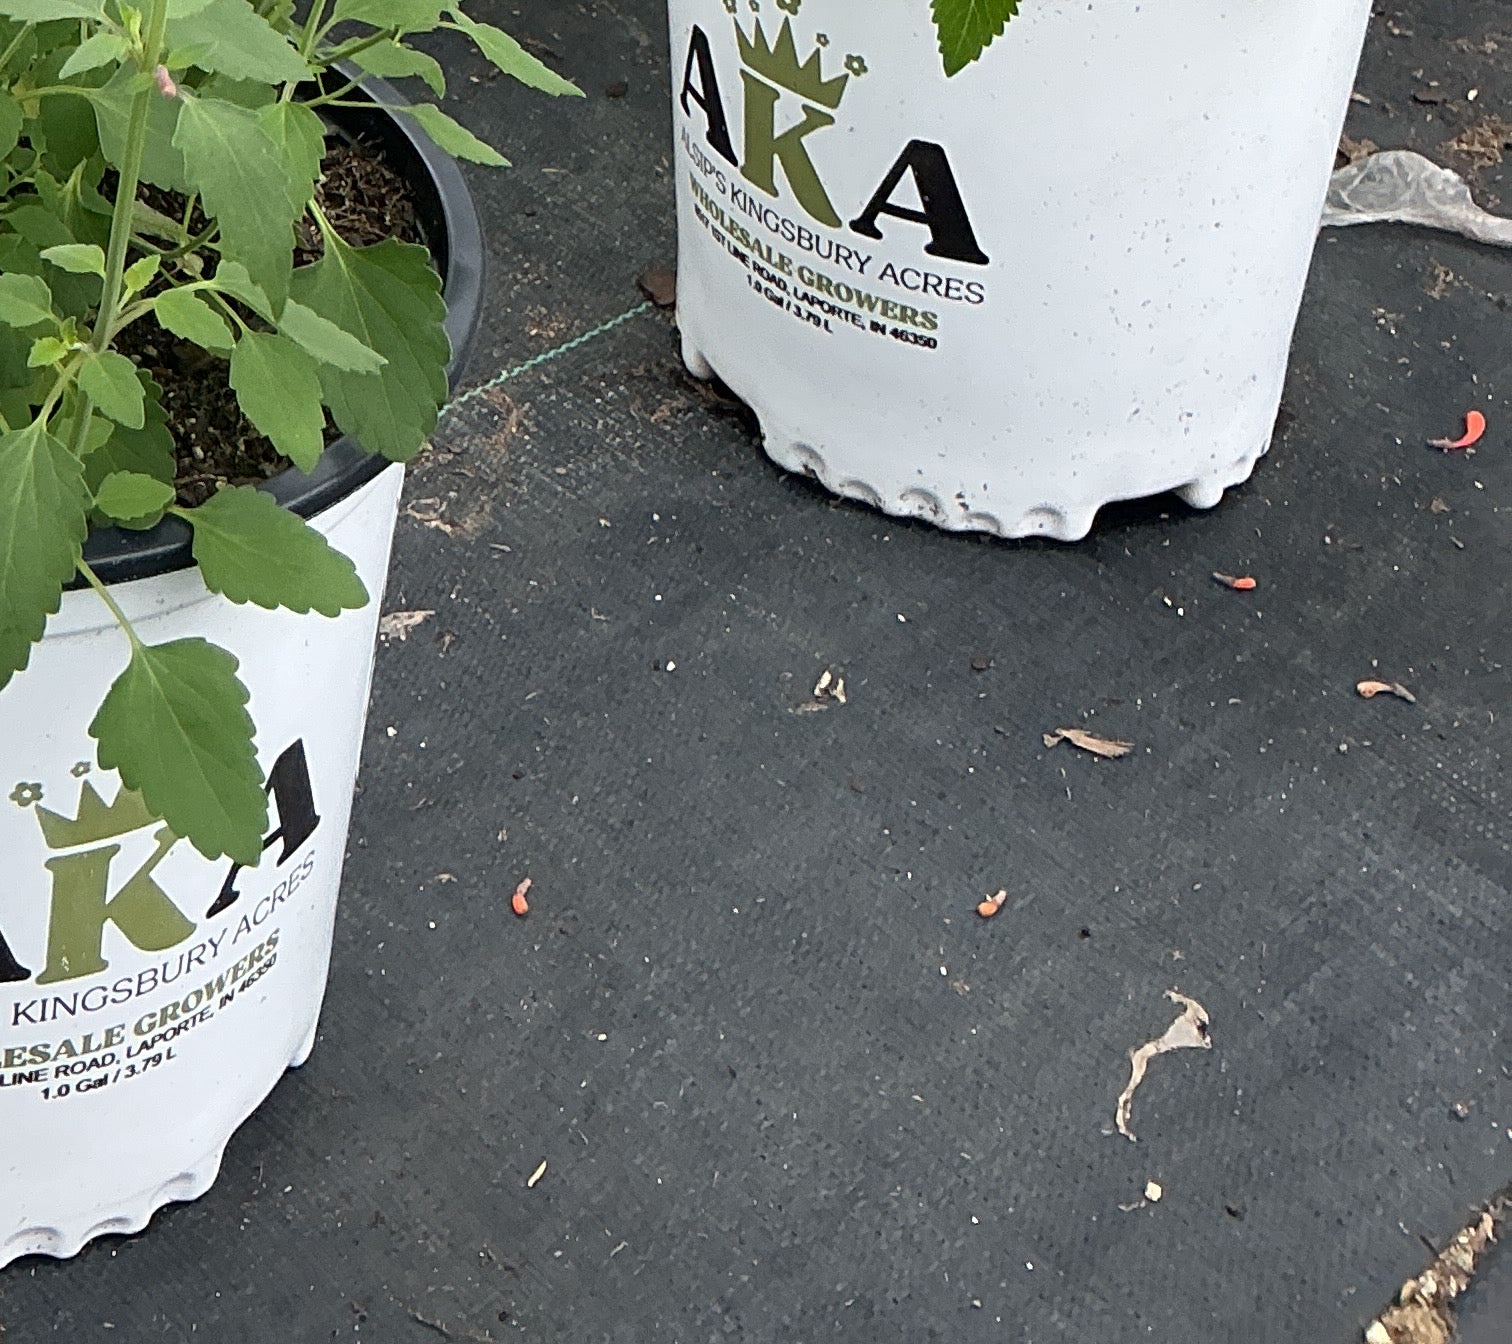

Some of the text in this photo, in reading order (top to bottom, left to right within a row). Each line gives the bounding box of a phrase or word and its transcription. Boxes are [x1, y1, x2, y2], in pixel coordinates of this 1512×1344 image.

[680, 23, 990, 266] AKA
[689, 170, 939, 331] WHOLESALE GROWERS
[730, 182, 873, 275] KINGSBURY
[878, 262, 985, 305] ACRES
[793, 287, 866, 331] LAPORTE,
[869, 319, 887, 336] IN
[11, 928, 227, 1026] KINGSBURY
[232, 850, 316, 945] ACRES
[133, 927, 280, 1037] GROWERS
[41, 1047, 178, 1101] 1.0 Gal / 3.79 L
[54, 1052, 120, 1079] ROAD,
[126, 1005, 215, 1059] LAPORTE,
[218, 988, 235, 1011] IN
[238, 952, 277, 994] 46350
